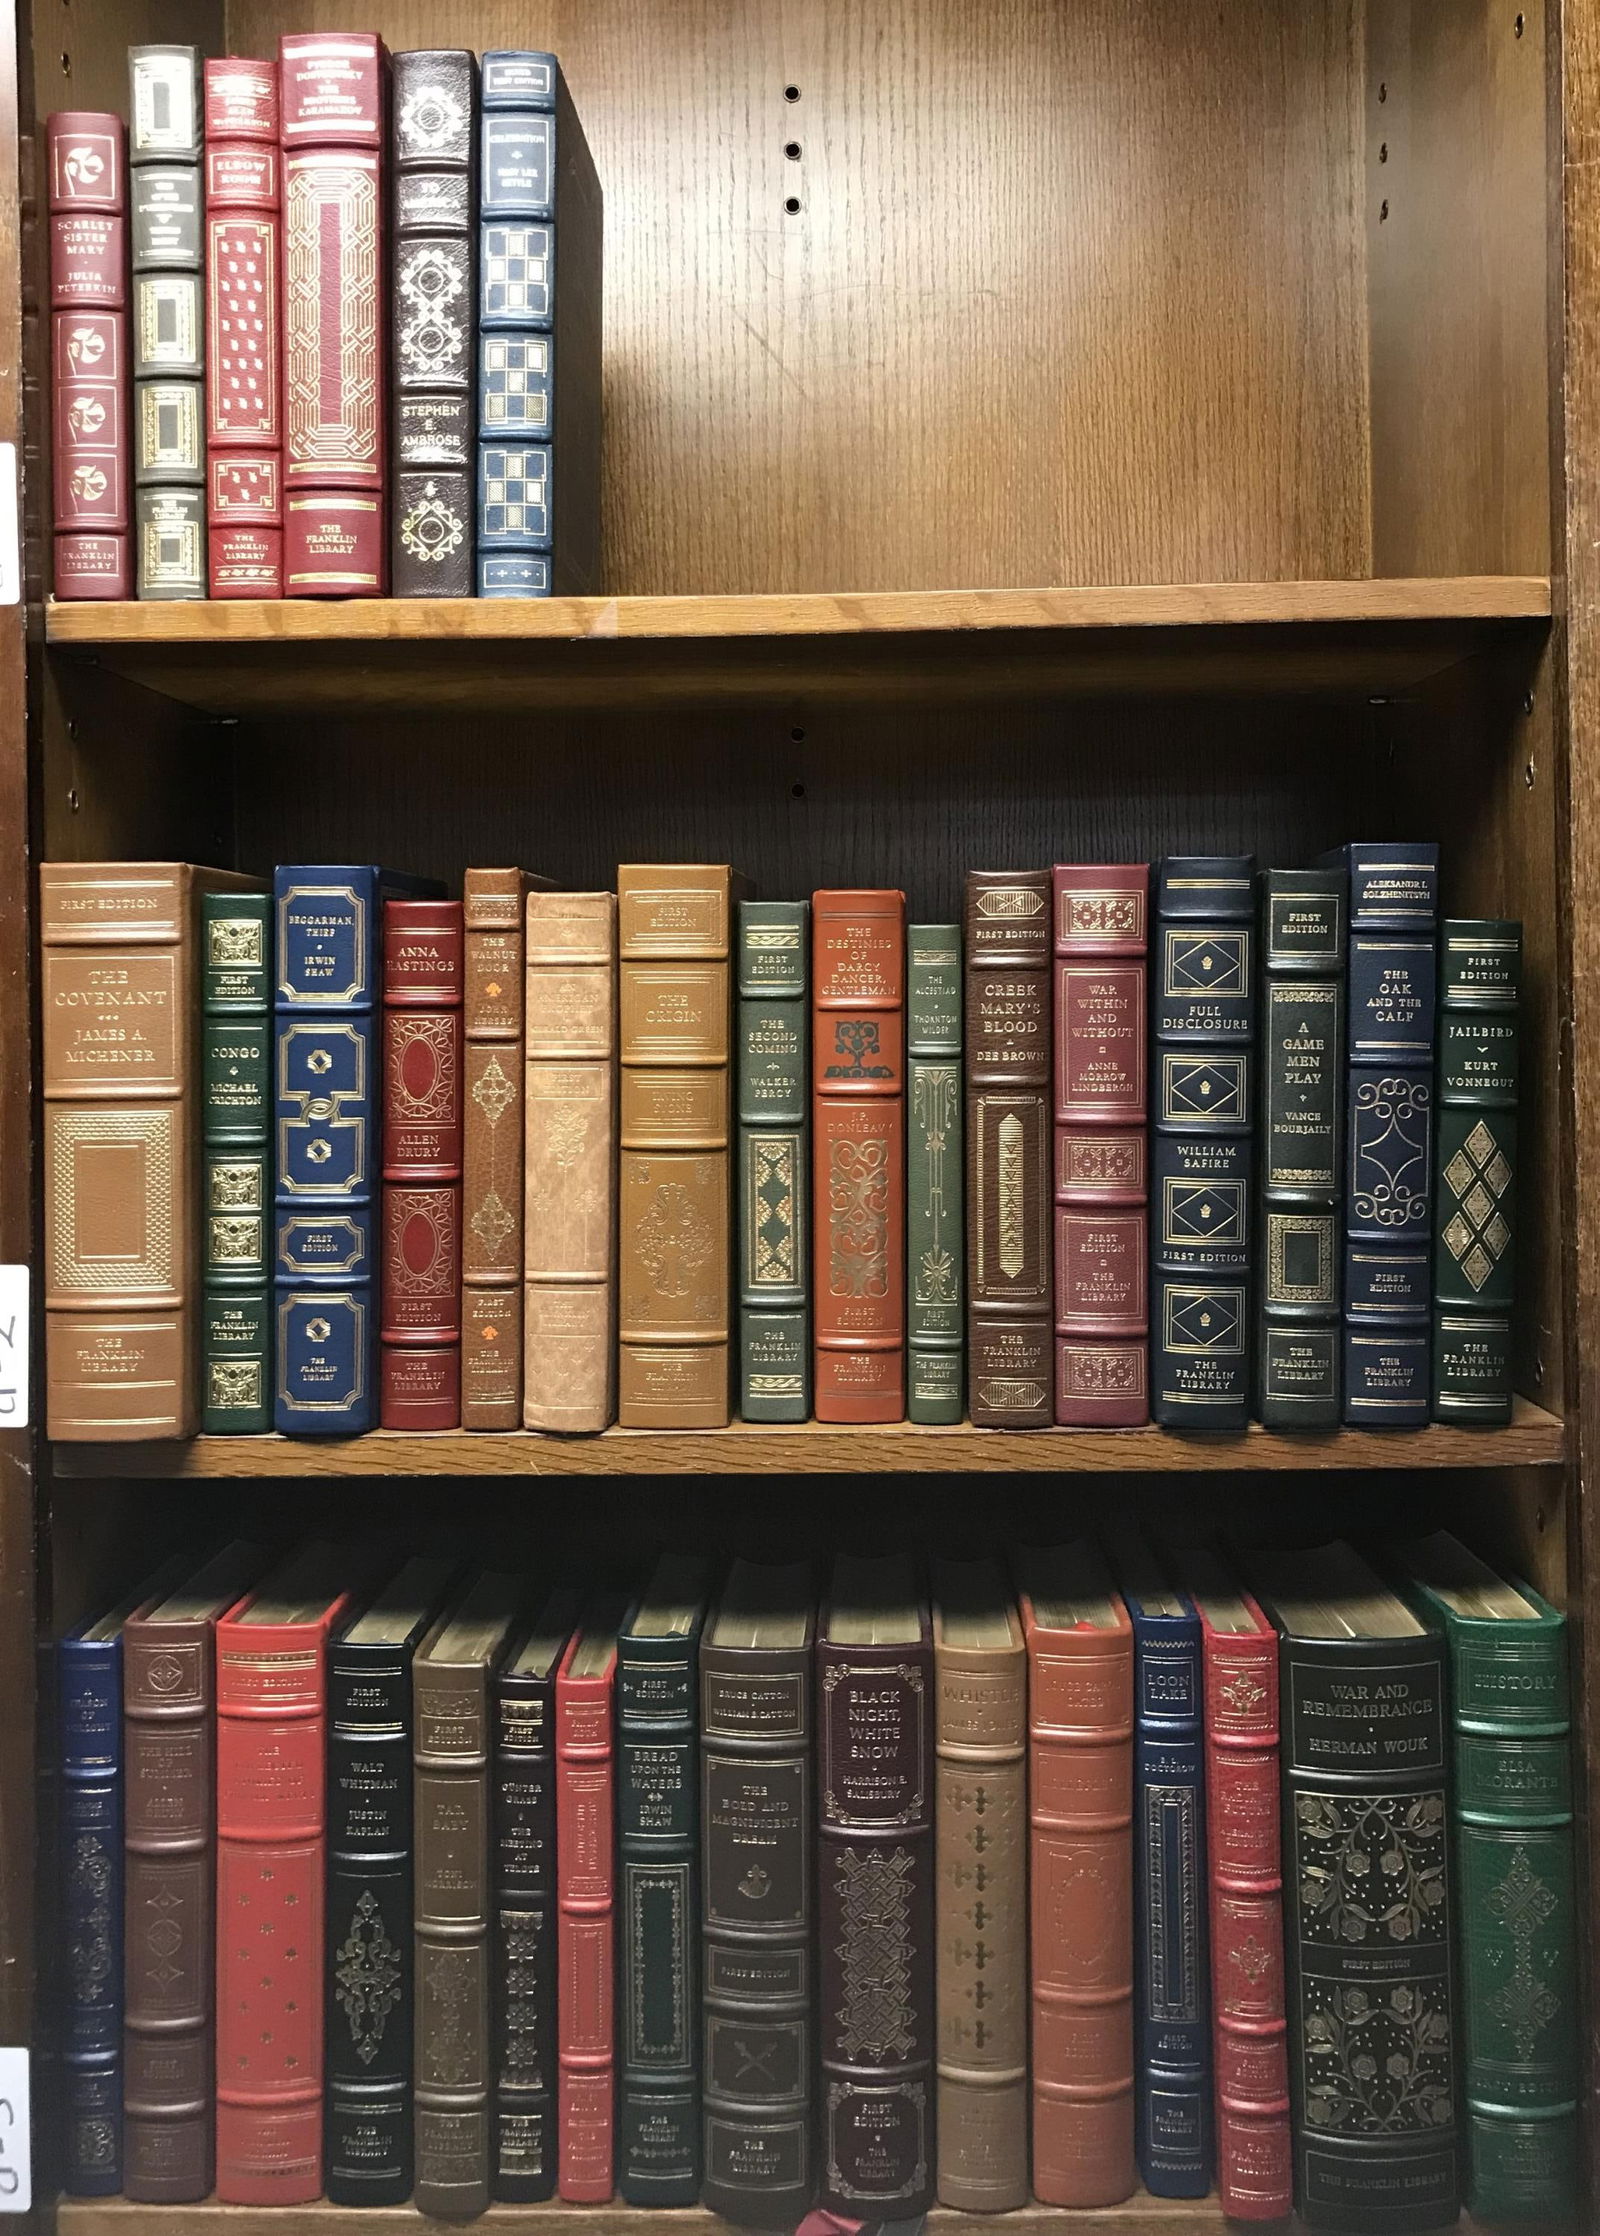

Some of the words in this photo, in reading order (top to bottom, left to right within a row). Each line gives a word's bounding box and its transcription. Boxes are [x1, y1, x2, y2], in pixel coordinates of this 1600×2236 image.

[57, 221, 113, 231] SCARLET
[63, 233, 107, 242] SISTER
[66, 245, 105, 255] MARY
[68, 272, 102, 281] JULIA
[403, 406, 460, 416] STEPHEN
[425, 421, 437, 430] E.
[402, 435, 461, 446] AMBROSE
[306, 535, 357, 544] FRANKLIN
[309, 545, 353, 554] LIBRARY
[1366, 881, 1420, 889] ALEKSANDR
[1363, 891, 1430, 899] SOLZHENITSYN
[60, 900, 94, 910] FIRST
[98, 899, 157, 909] EDITION
[658, 908, 687, 917] FIRST
[289, 916, 354, 926] BEGGARMAN,
[650, 918, 696, 928] EDITION
[847, 928, 871, 936] THE
[1282, 925, 1328, 933] EDITION
[483, 938, 505, 946] THE
[398, 947, 439, 957] ANNA
[851, 952, 867, 960] OF
[305, 957, 336, 965] IRWIN
[758, 956, 788, 964] FIRST
[1468, 958, 1501, 966] FIRST
[751, 966, 794, 974] EDITION
[838, 963, 880, 972] DARCY
[89, 971, 128, 984] THE
[305, 969, 334, 977] SHAW
[1384, 971, 1408, 979] THE
[1460, 972, 1508, 980] EDITION
[220, 976, 248, 984] FIRST
[832, 975, 886, 983] DANCER,
[822, 986, 896, 995] GENTLEMAN
[985, 985, 1037, 996] CREEK
[1089, 985, 1117, 995] WAR
[1380, 984, 1411, 993] OAK
[55, 992, 167, 1006] COVENANT
[658, 995, 688, 1006] THE
[1367, 999, 1393, 1007] AND
[1399, 999, 1421, 1007] THE
[981, 1003, 1040, 1014] MARY'S
[1078, 1000, 1127, 1009] WITHIN
[1189, 1006, 1221, 1016] FULL
[646, 1011, 701, 1022] ORIGIN
[914, 1015, 957, 1024] THORNTON
[1088, 1014, 1117, 1023] AND
[1376, 1012, 1414, 1022] CALF
[760, 1020, 784, 1029] THE
[984, 1022, 1037, 1033] BLOOD
[1163, 1019, 1248, 1029] DISCLOSURE
[1298, 1023, 1309, 1032] A
[922, 1026, 949, 1034] WILDER
[1072, 1028, 1133, 1037] WITHOUT
[1449, 1027, 1513, 1038] JAILBIRD
[74, 1029, 126, 1045] JAMES
[131, 1029, 147, 1040] A.
[749, 1032, 797, 1041] SECOND
[1283, 1039, 1324, 1049] GAME
[211, 1048, 260, 1058] CONGO
[749, 1044, 797, 1054] COMING
[66, 1050, 155, 1062] MICHENER
[977, 1052, 998, 1060] DEE
[1002, 1052, 1044, 1060] BROWN
[1287, 1057, 1320, 1067] MEN
[1464, 1062, 1498, 1070] KURT
[751, 1078, 796, 1086] WALKER
[1285, 1073, 1322, 1083] PLAY
[1447, 1077, 1514, 1087] VONNEGUT
[211, 1084, 258, 1092] MICHAEL
[755, 1089, 791, 1098] PERCY
[209, 1096, 261, 1105] CRICHTON
[1285, 1112, 1321, 1120] VANCE
[1274, 1125, 1332, 1134] BOURJAILY
[399, 1135, 439, 1144] ALLEN
[397, 1147, 440, 1157] DRURY
[1177, 1147, 1236, 1156] WILLIAM
[1184, 1159, 1229, 1168] SAFIRE
[1163, 1251, 1194, 1261] FIRST
[1200, 1253, 1246, 1262] EDITION
[1375, 1274, 1405, 1282] FIRST
[1370, 1284, 1411, 1292] EDITION
[1000, 1336, 1023, 1344] THE
[984, 1347, 1040, 1356] FRANKLIN
[1464, 1344, 1488, 1352] THE
[988, 1358, 1036, 1367] LIBRARY
[1380, 1358, 1400, 1366] THE
[1443, 1355, 1504, 1364] FRANKLIN
[1195, 1361, 1217, 1369] THE
[1176, 1370, 1235, 1379] FRANKLIN
[1365, 1368, 1414, 1376] FRANKLIN
[1448, 1367, 1501, 1376] LIBRARY
[1180, 1380, 1230, 1389] LIBRARY
[1367, 1378, 1411, 1386] LIBRARY
[1148, 1675, 1190, 1686] LOON
[636, 1689, 674, 1698] EDITION
[719, 1690, 747, 1700] BRUCE
[751, 1692, 789, 1700] CATTON
[1151, 1690, 1187, 1699] LAKE
[1331, 1685, 1369, 1699] WAR
[1375, 1685, 1409, 1697] AND
[850, 1691, 900, 1703] BLACK
[1303, 1700, 1432, 1717] REMEMBRANCE
[760, 1709, 795, 1718] CATTON
[849, 1709, 901, 1721] NIGHT,
[850, 1728, 900, 1739] WHITE
[1309, 1738, 1376, 1753] HERMAN
[1384, 1738, 1428, 1751] WOUK
[634, 1752, 678, 1761] BREAD
[851, 1746, 898, 1758] SNOW
[351, 1764, 384, 1772] WALT
[632, 1765, 659, 1774] UPON
[1499, 1761, 1536, 1772] ELSA
[340, 1779, 397, 1789] WHITMAN
[631, 1778, 682, 1789] WATERS
[843, 1776, 899, 1786] HARRISON
[743, 1785, 767, 1795] THE
[847, 1790, 900, 1799] SALISBURY
[722, 1799, 755, 1811] BOLD
[762, 1802, 789, 1811] AND
[640, 1806, 672, 1814] IRWIN
[640, 1818, 672, 1826] SHAW
[713, 1815, 798, 1828] MAGNIFICENT
